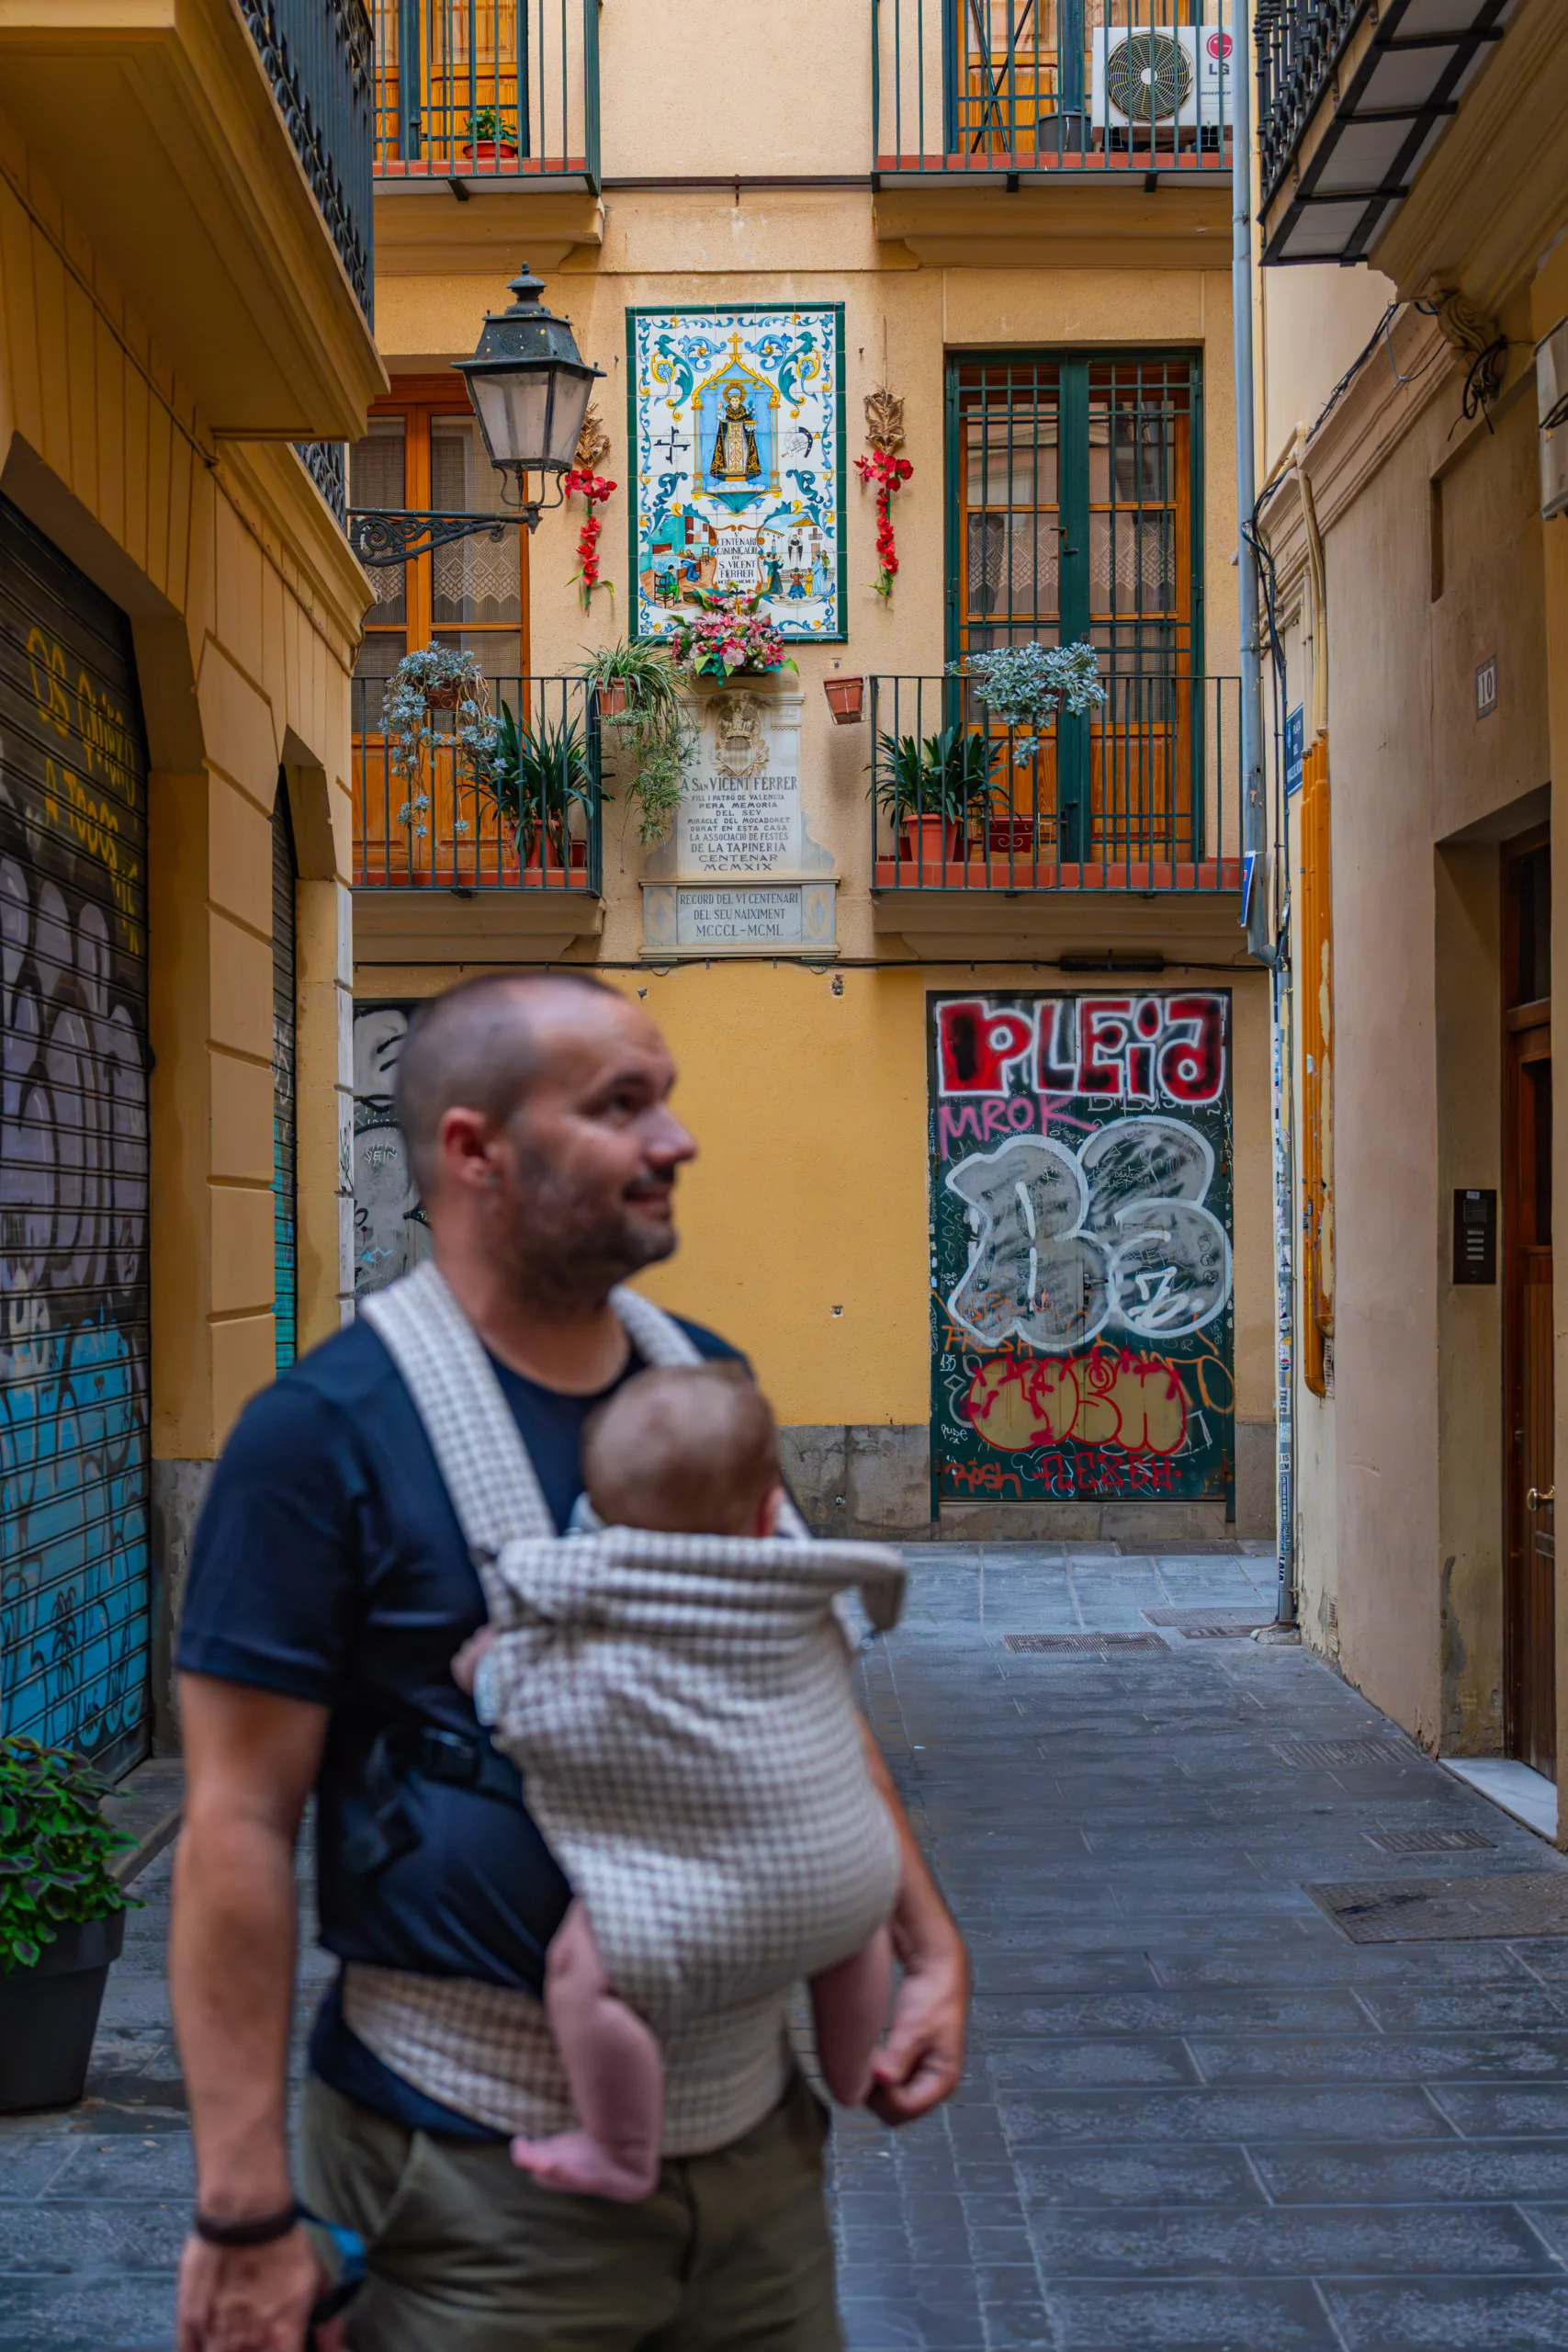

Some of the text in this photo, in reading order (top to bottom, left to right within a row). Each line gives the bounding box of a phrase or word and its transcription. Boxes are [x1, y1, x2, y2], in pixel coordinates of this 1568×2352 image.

[1209, 63, 1230, 75] LG
[728, 560, 756, 569] VICENT
[720, 569, 754, 578] FERRER
[1482, 670, 1493, 704] 10
[709, 776, 750, 791] VICENT
[753, 776, 797, 790] FERRER
[690, 833, 700, 842] LA
[749, 832, 758, 841] DE
[761, 832, 789, 841] FESTES
[691, 842, 786, 853] DE LA TAPINERIA
[680, 892, 798, 905] RECORD DEL VI CENTENARI
[694, 908, 785, 920] DEL SEU NAIXIMENT
[939, 1093, 1098, 1161] MROK
